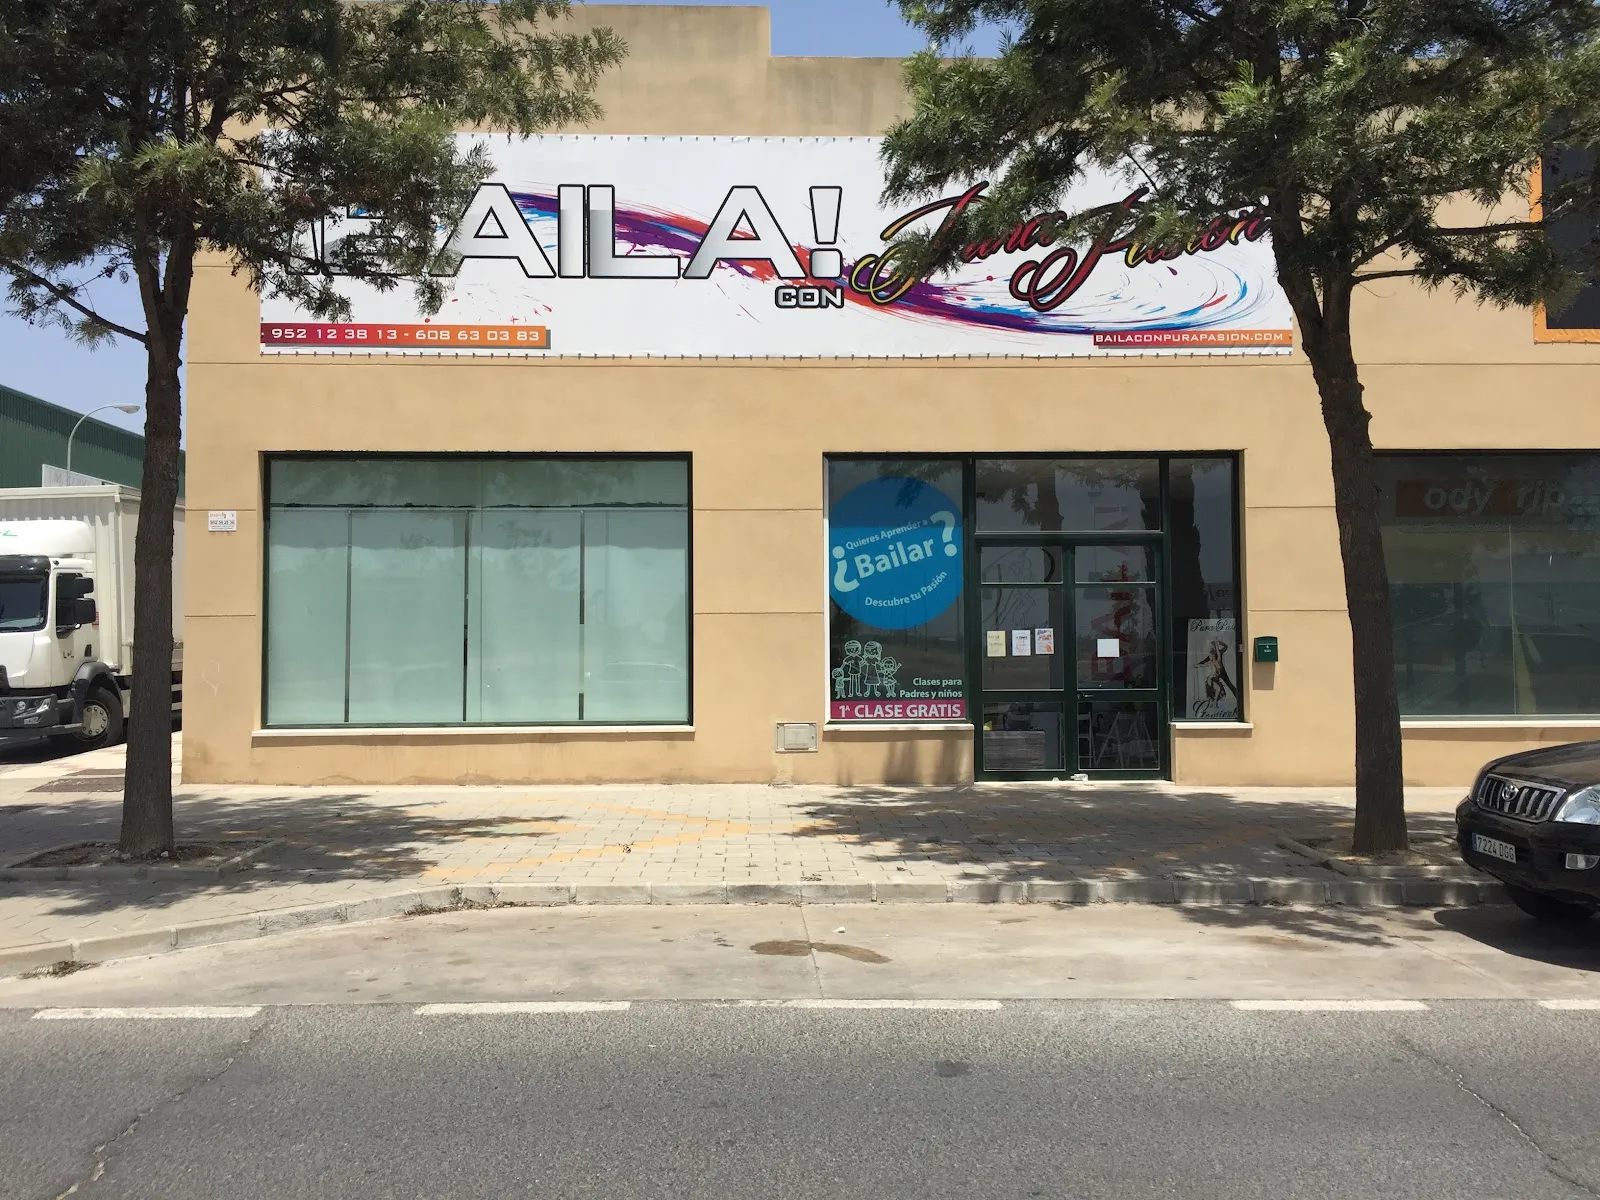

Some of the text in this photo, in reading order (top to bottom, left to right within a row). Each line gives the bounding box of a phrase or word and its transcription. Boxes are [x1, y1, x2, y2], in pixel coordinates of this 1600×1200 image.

[775, 285, 845, 309] CON
[271, 328, 307, 339] 952
[316, 329, 338, 340] 12
[344, 329, 368, 340] 38
[376, 329, 398, 340] 13
[415, 330, 451, 341] 608
[457, 330, 480, 341] 63
[487, 331, 510, 341] 03
[516, 331, 540, 342] 83
[1095, 333, 1284, 344] BAILACONPURAPASION.COM
[846, 533, 880, 550] Quieres
[880, 521, 921, 540] Aprender
[864, 571, 948, 607] Descubre tu Pasión
[913, 677, 963, 688] Clases para
[900, 689, 963, 699] Padres y niños
[854, 704, 903, 718] CLASE
[906, 703, 961, 718] GRATIS
[1477, 836, 1497, 854] 7224
